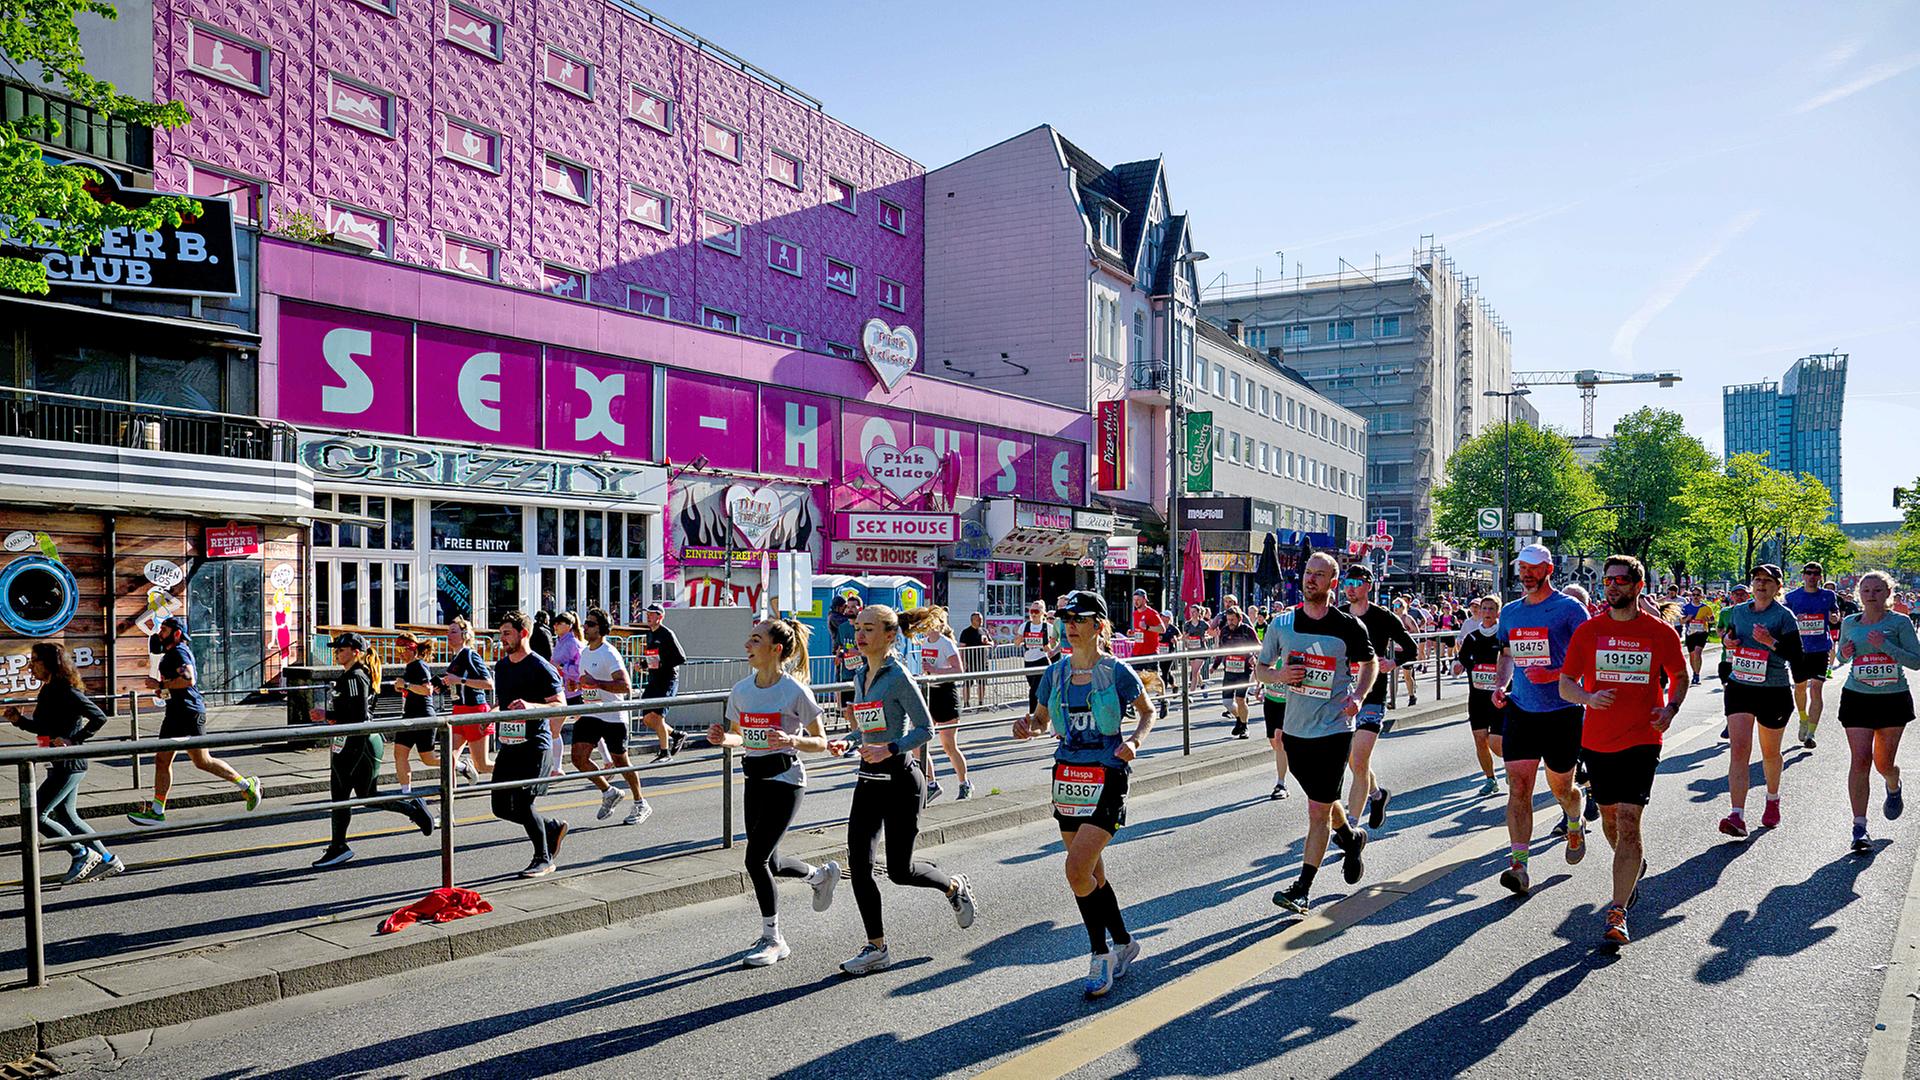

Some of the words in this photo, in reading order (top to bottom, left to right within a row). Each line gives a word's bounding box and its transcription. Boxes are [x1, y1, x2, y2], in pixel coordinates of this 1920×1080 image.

[175, 231, 219, 264] B.
[41, 253, 152, 285] CLUB
[1188, 423, 1212, 476] Carlsberg
[883, 452, 924, 464] Pink
[872, 466, 934, 479] Palace
[856, 520, 887, 533] SEX
[893, 521, 948, 535] HOUSE
[210, 536, 247, 547] REEPER
[247, 536, 256, 546] B.
[444, 538, 472, 549] FREE
[475, 539, 510, 551] ENTRY
[224, 546, 244, 555] CLUB
[731, 551, 751, 560] FREI
[856, 547, 878, 562] SEX
[880, 548, 918, 564] HOUSE
[150, 563, 181, 579] LEINEN
[153, 574, 171, 586] LOS
[1617, 640, 1640, 648] Haspa
[73, 647, 100, 667] B.
[1306, 657, 1326, 666] Haspa
[1070, 770, 1094, 780] Haspa
